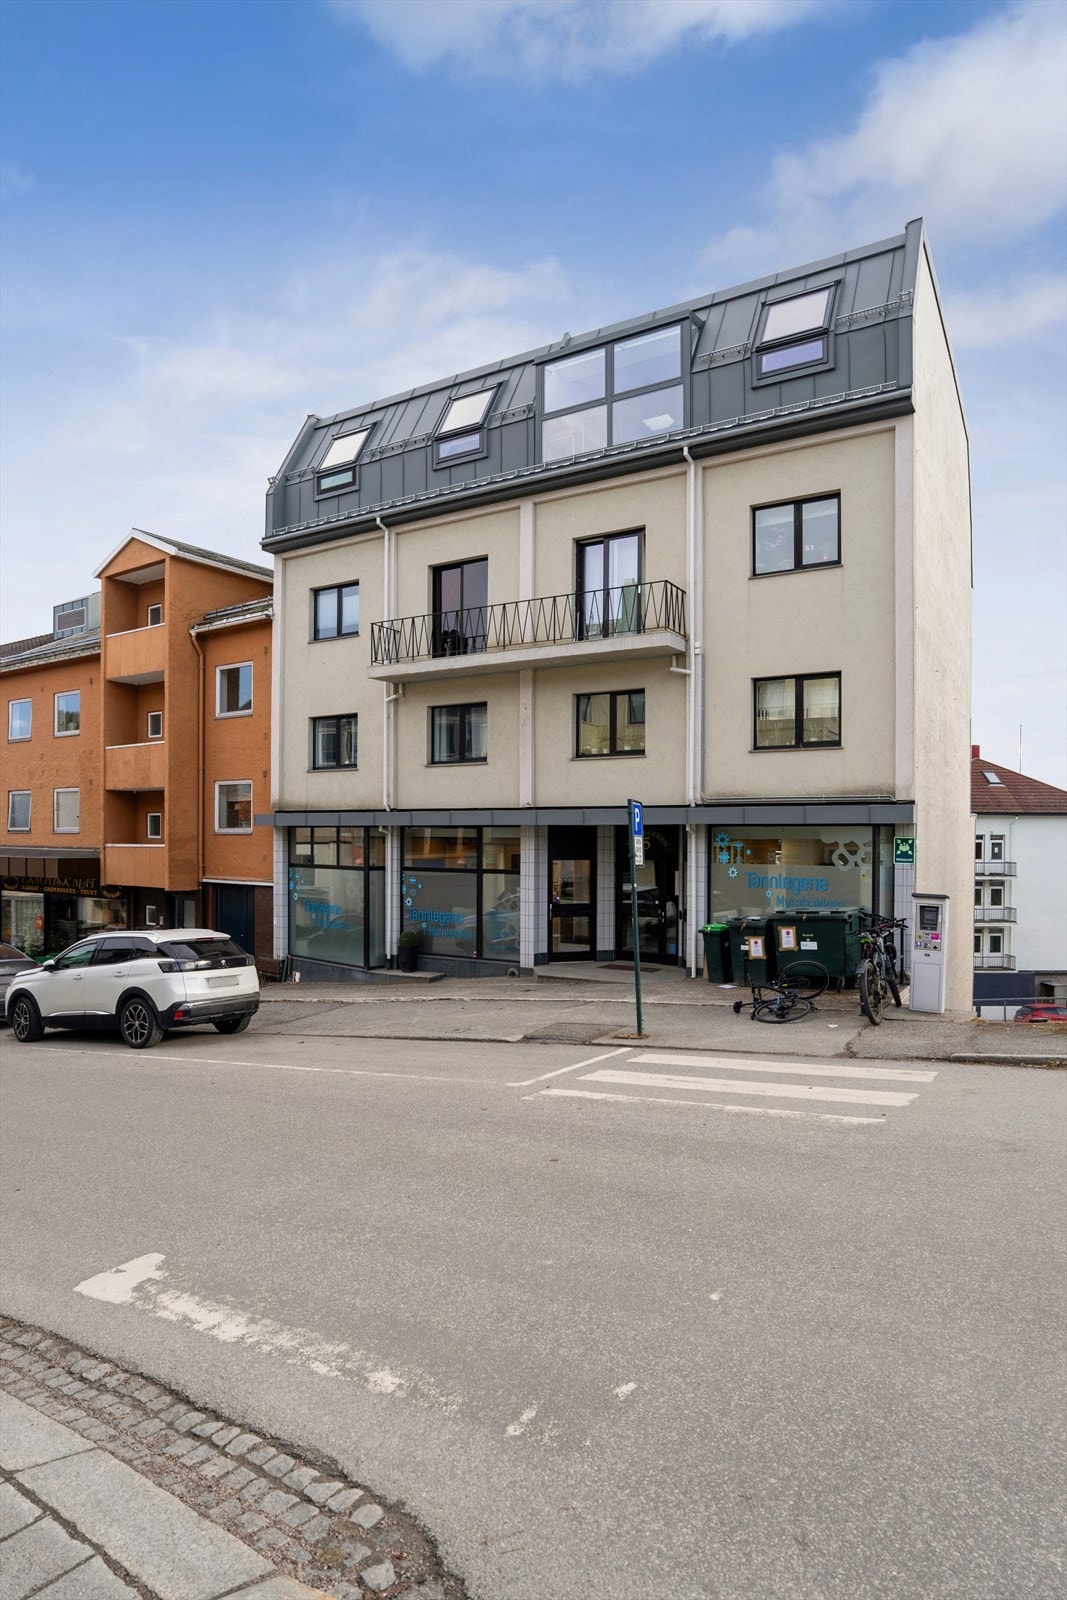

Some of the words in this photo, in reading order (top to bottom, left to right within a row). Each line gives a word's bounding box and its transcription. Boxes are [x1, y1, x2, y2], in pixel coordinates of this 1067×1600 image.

[634, 808, 640, 831] P
[744, 871, 829, 896] Tannlegene
[407, 907, 465, 926] Tannlegene
